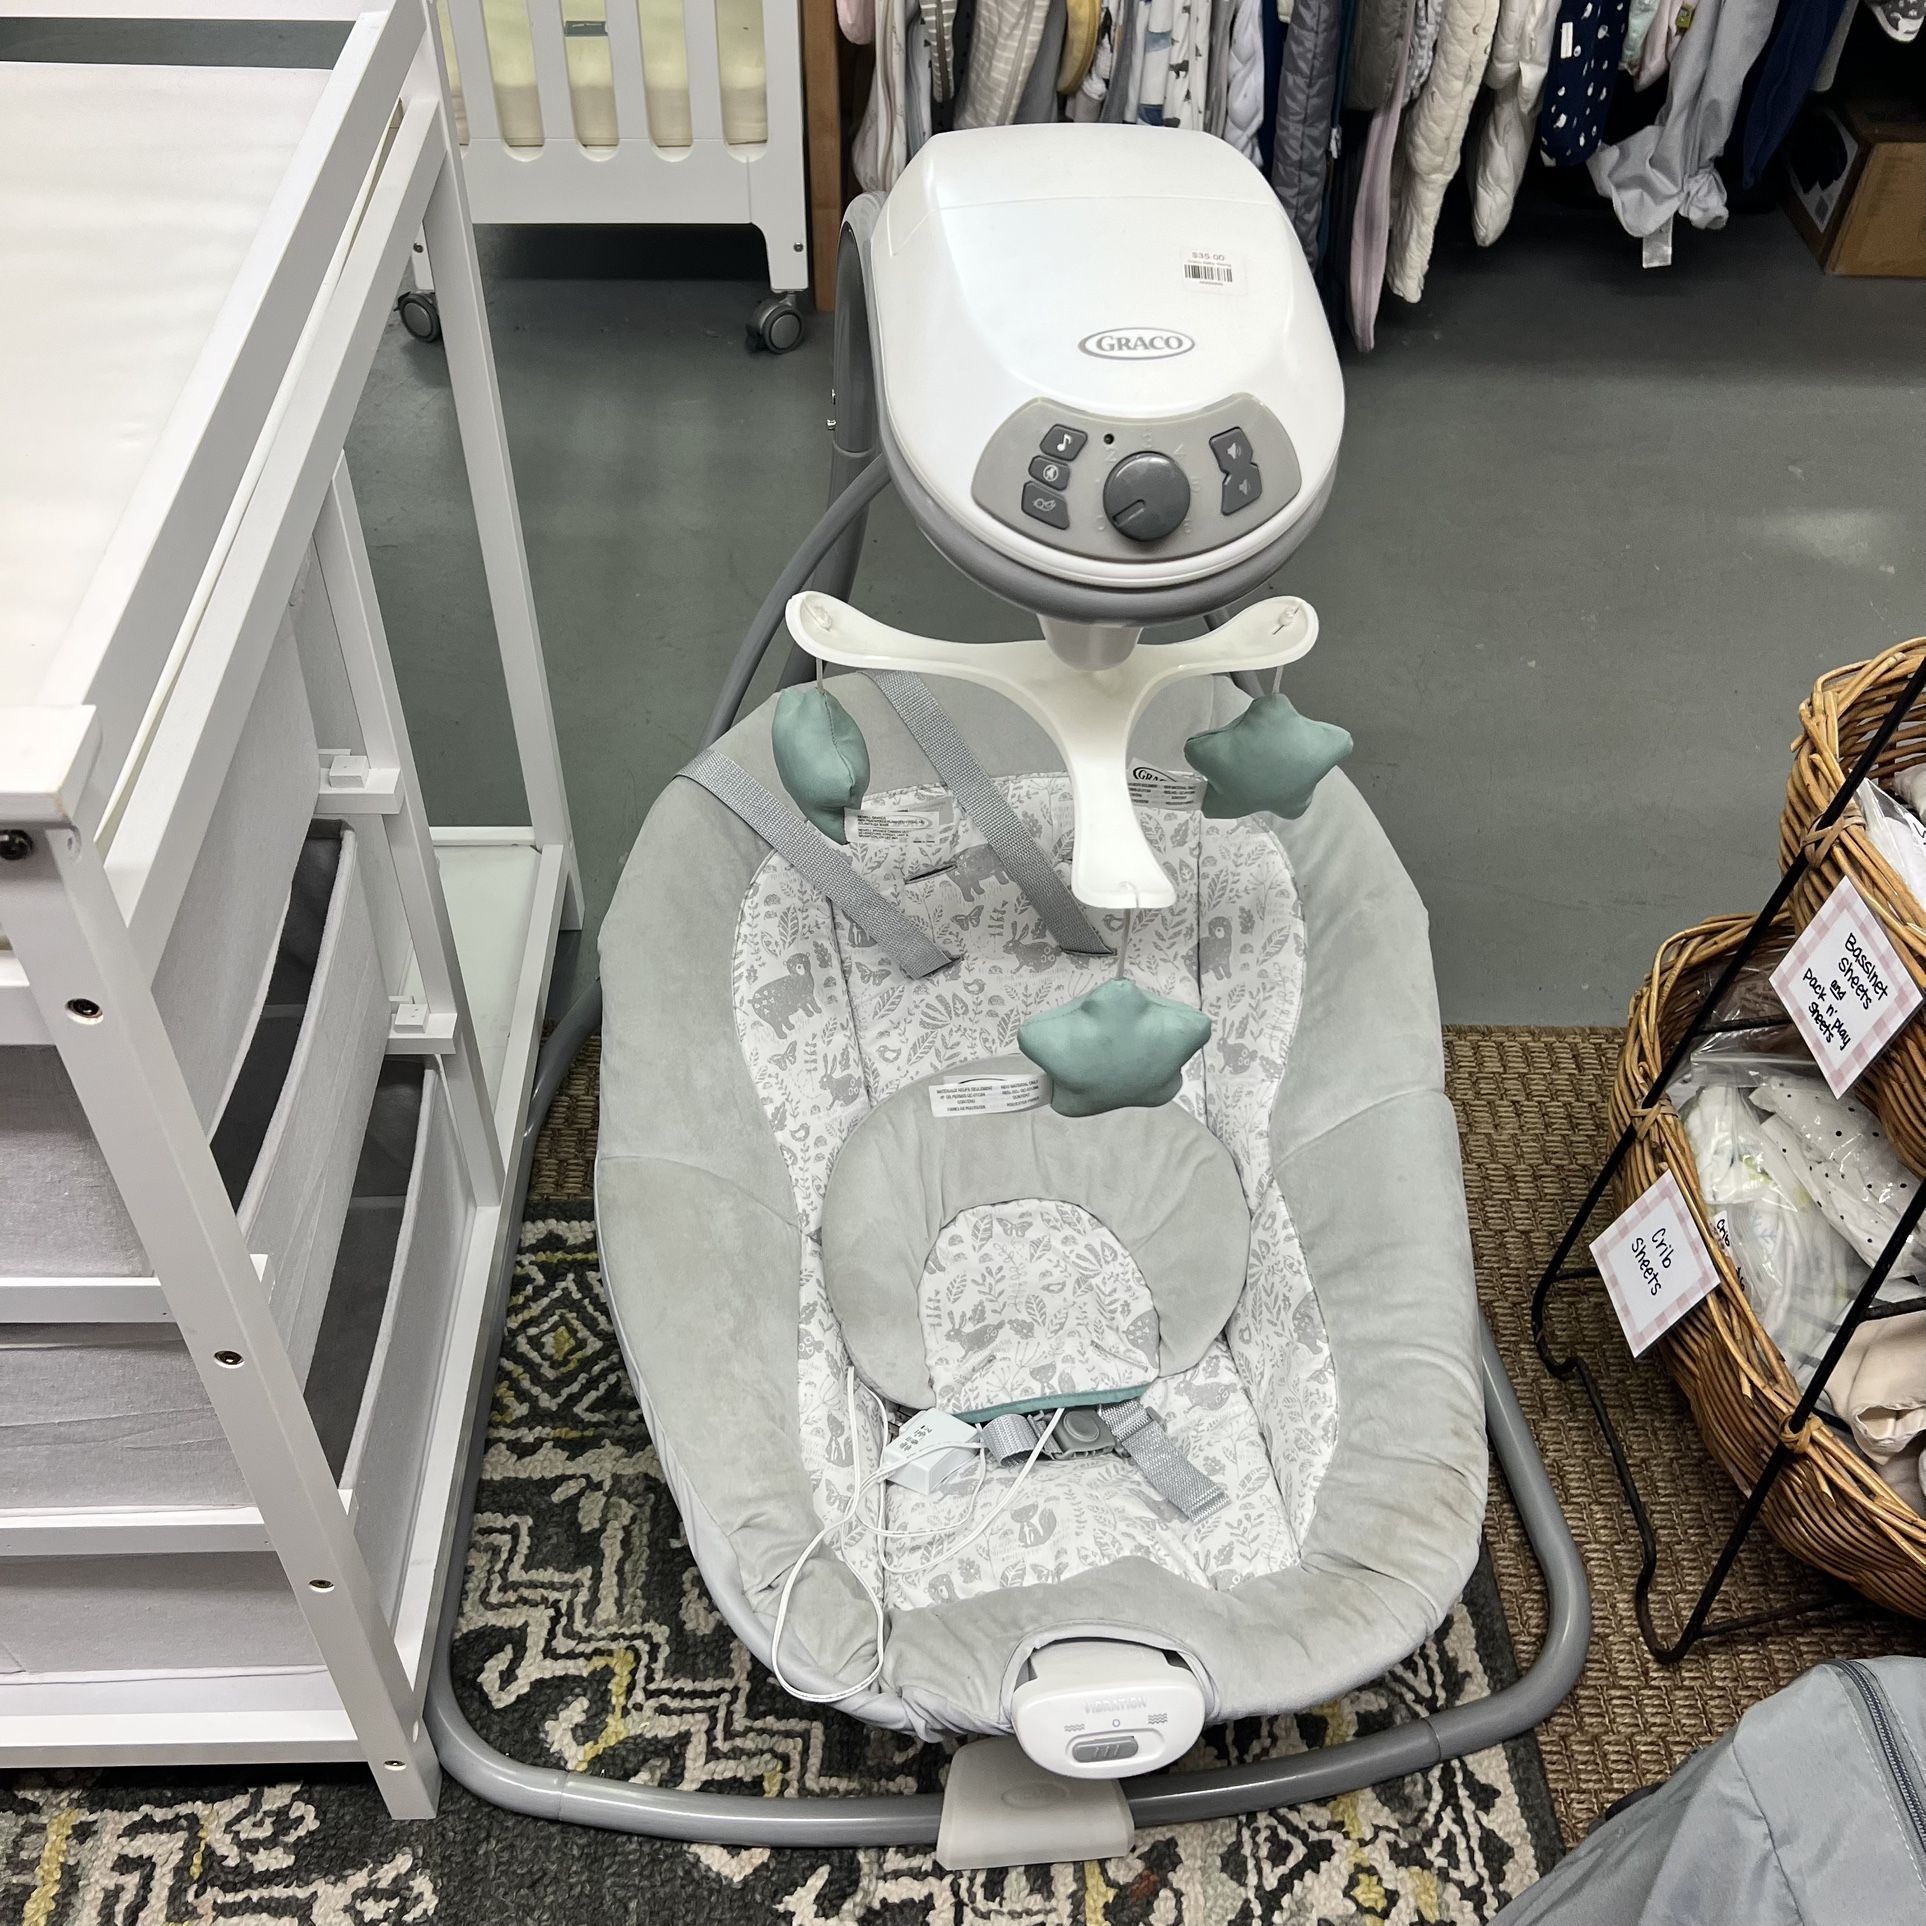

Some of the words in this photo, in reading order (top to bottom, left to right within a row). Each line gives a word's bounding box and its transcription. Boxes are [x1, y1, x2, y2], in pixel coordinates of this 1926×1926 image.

[1096, 335, 1184, 352] GRACO
[1829, 979, 1847, 1001] and
[1651, 1227, 1675, 1269] Crib
[1631, 1237, 1662, 1297] Sheets
[1083, 1696, 1148, 1714] VIBRATION
